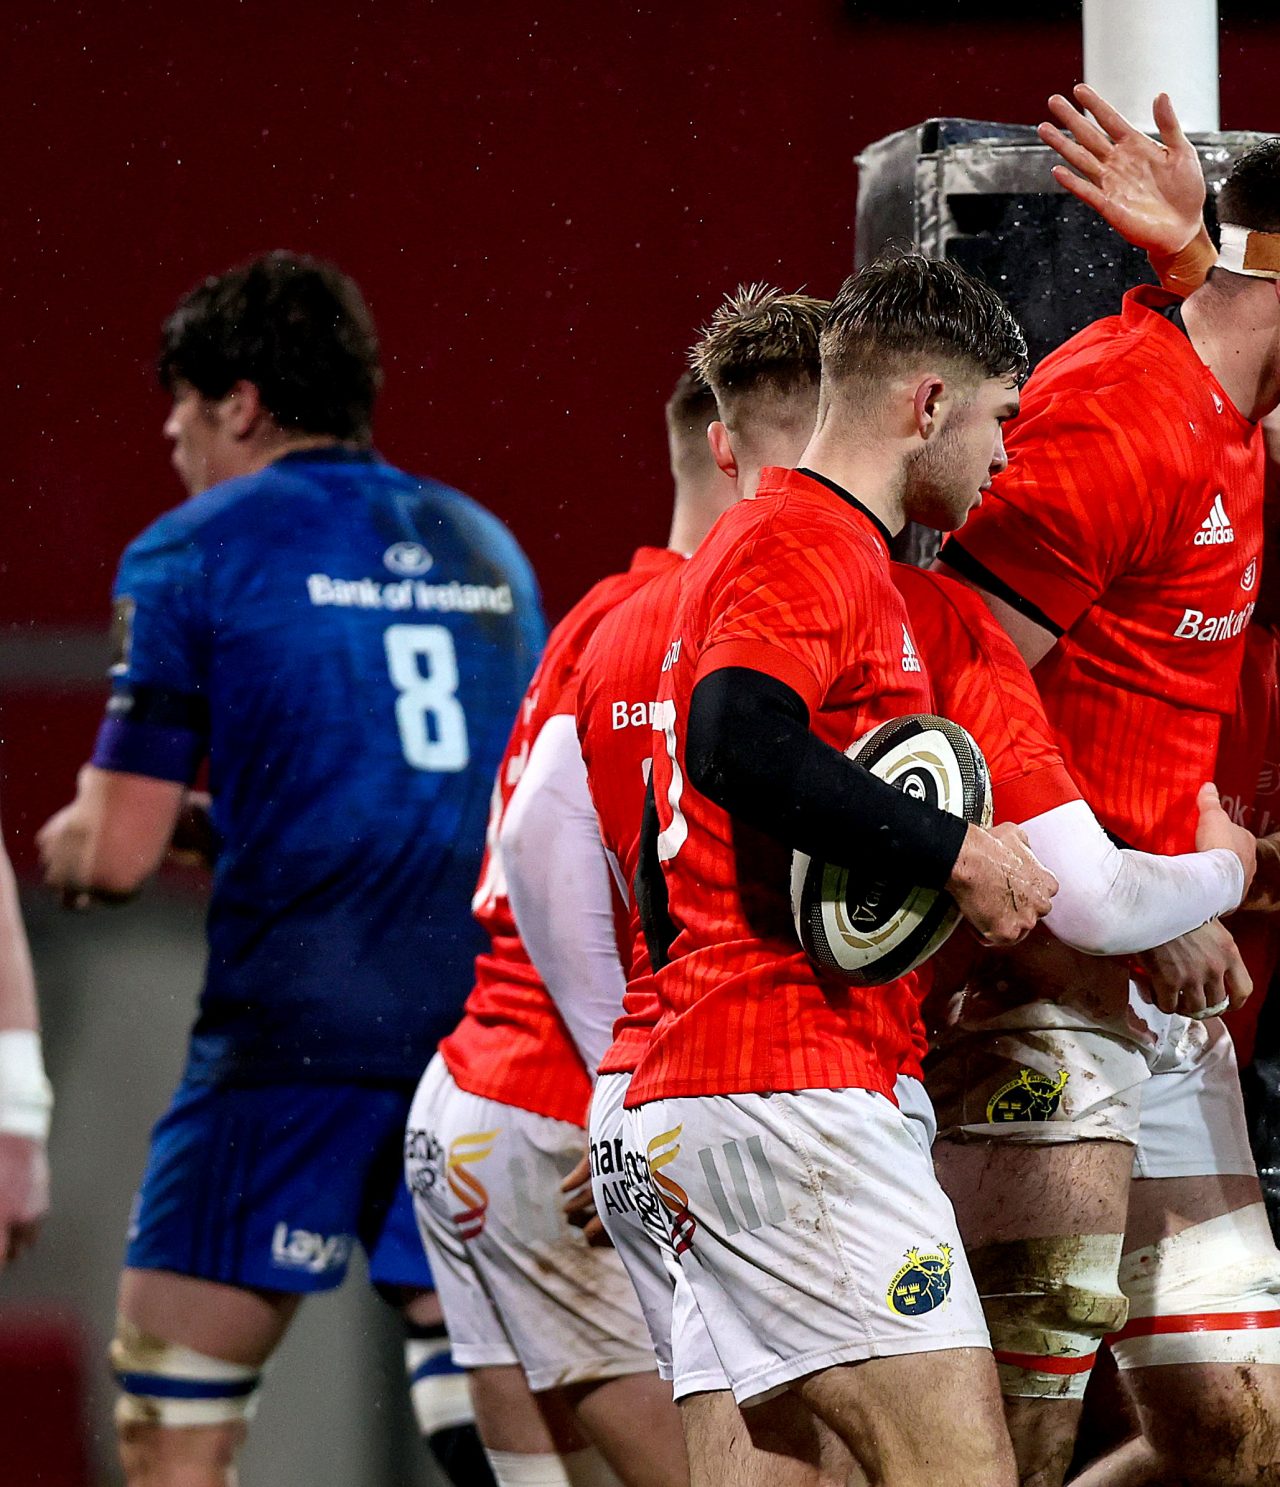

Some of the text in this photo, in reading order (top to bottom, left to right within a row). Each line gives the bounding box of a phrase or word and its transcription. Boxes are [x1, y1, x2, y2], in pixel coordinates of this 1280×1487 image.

[1194, 527, 1234, 546] adidas
[307, 573, 514, 614] Bank of Ireland
[1173, 608, 1235, 642] Bank
[383, 623, 470, 773] 8
[887, 1263, 911, 1296] MUNSTER
